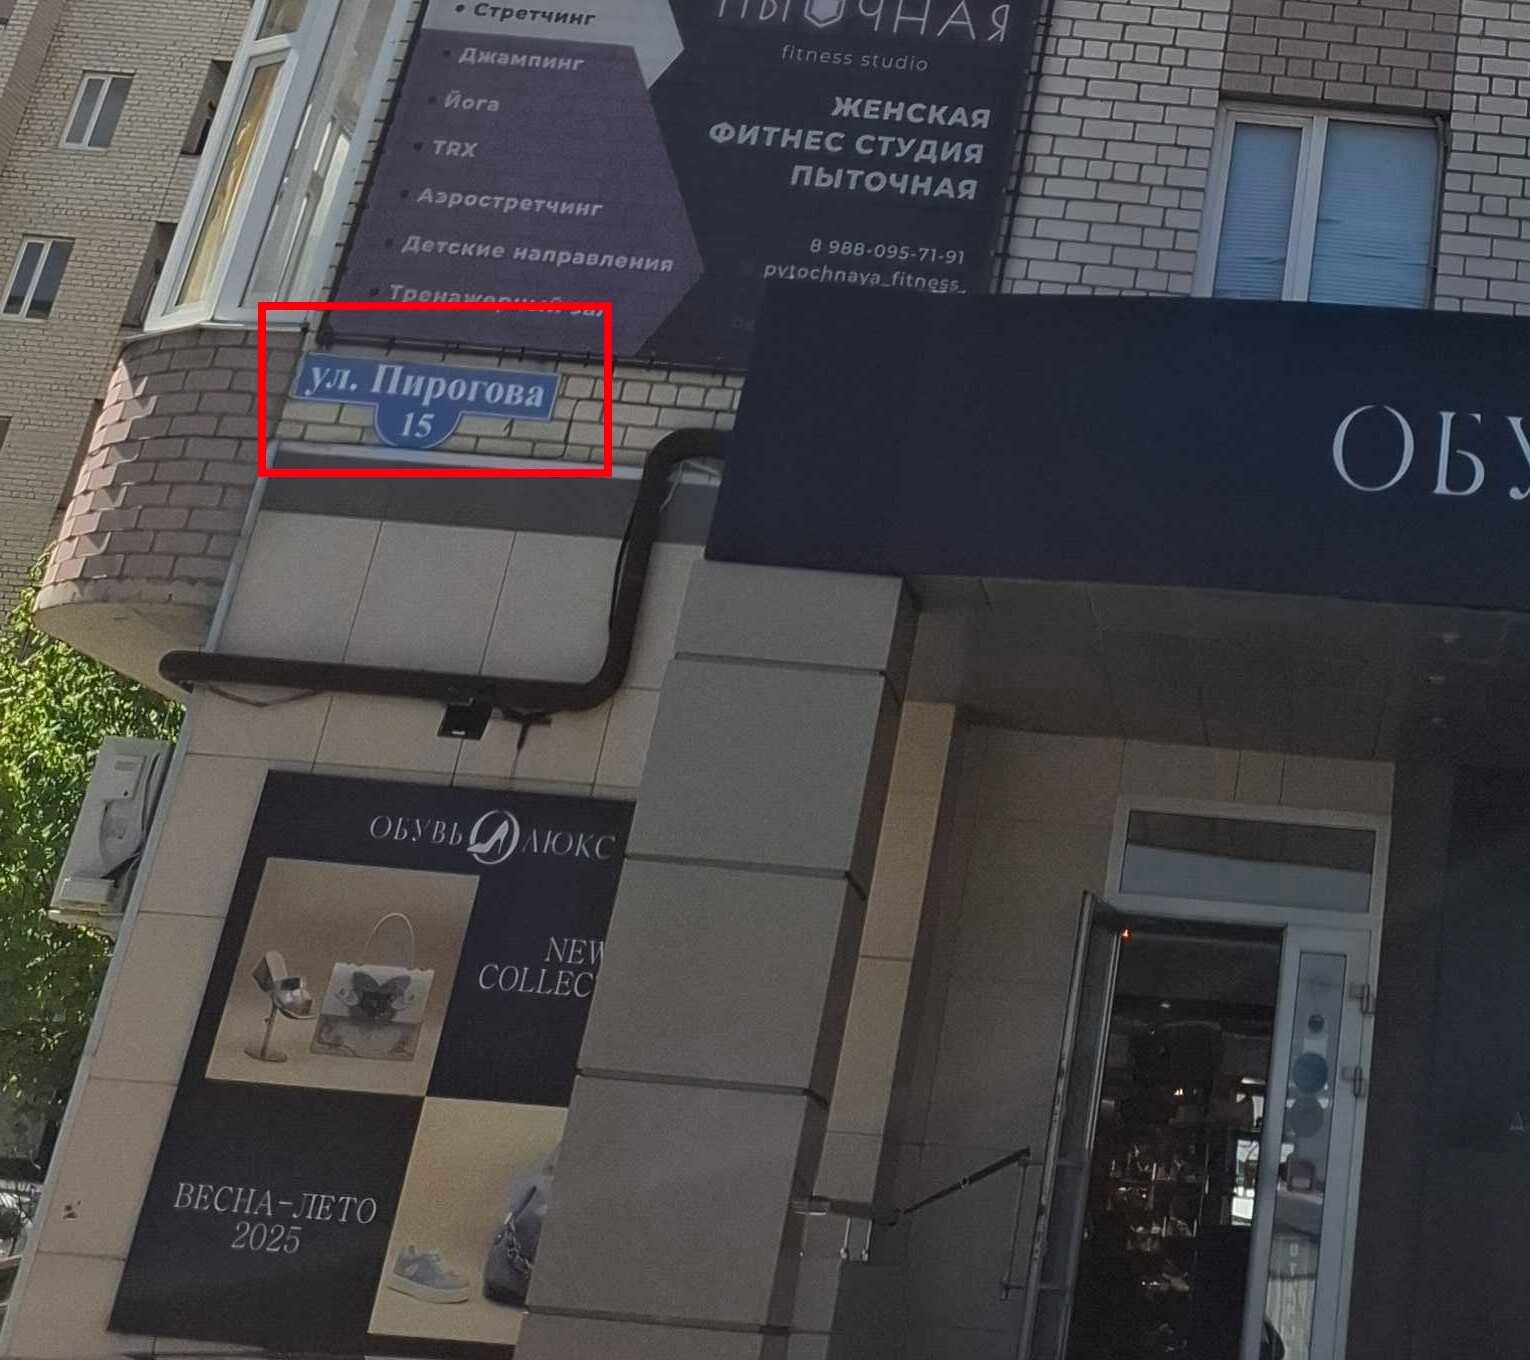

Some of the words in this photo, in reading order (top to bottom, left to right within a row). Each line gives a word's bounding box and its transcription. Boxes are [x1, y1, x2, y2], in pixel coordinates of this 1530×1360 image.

[473, 1, 597, 27] Стретчинг
[457, 46, 585, 73] Джампинг
[781, 43, 854, 66] fitness
[861, 49, 930, 73] studio
[443, 88, 501, 113] Йога
[831, 95, 992, 129] ЖЕНСКАЯ
[433, 139, 479, 159] TRX
[709, 121, 846, 153] ФИТНЕС
[855, 133, 985, 165] СТУДИЯ
[791, 164, 979, 201] ПЫТОЧНАЯ
[416, 187, 604, 217] Аэростретчинг
[401, 234, 506, 260] Детские
[512, 245, 675, 274] направления
[809, 238, 823, 254] 8
[828, 239, 965, 265] 988-095-71-91
[304, 366, 357, 397] ул.
[370, 363, 545, 409] Пирогова
[400, 412, 434, 438] 15
[369, 814, 463, 846] ОБУВЬ
[522, 828, 616, 861] ЛЮКС
[173, 1182, 378, 1224] ВЕСНА-ЛЕТО
[231, 1220, 302, 1255] 2025
